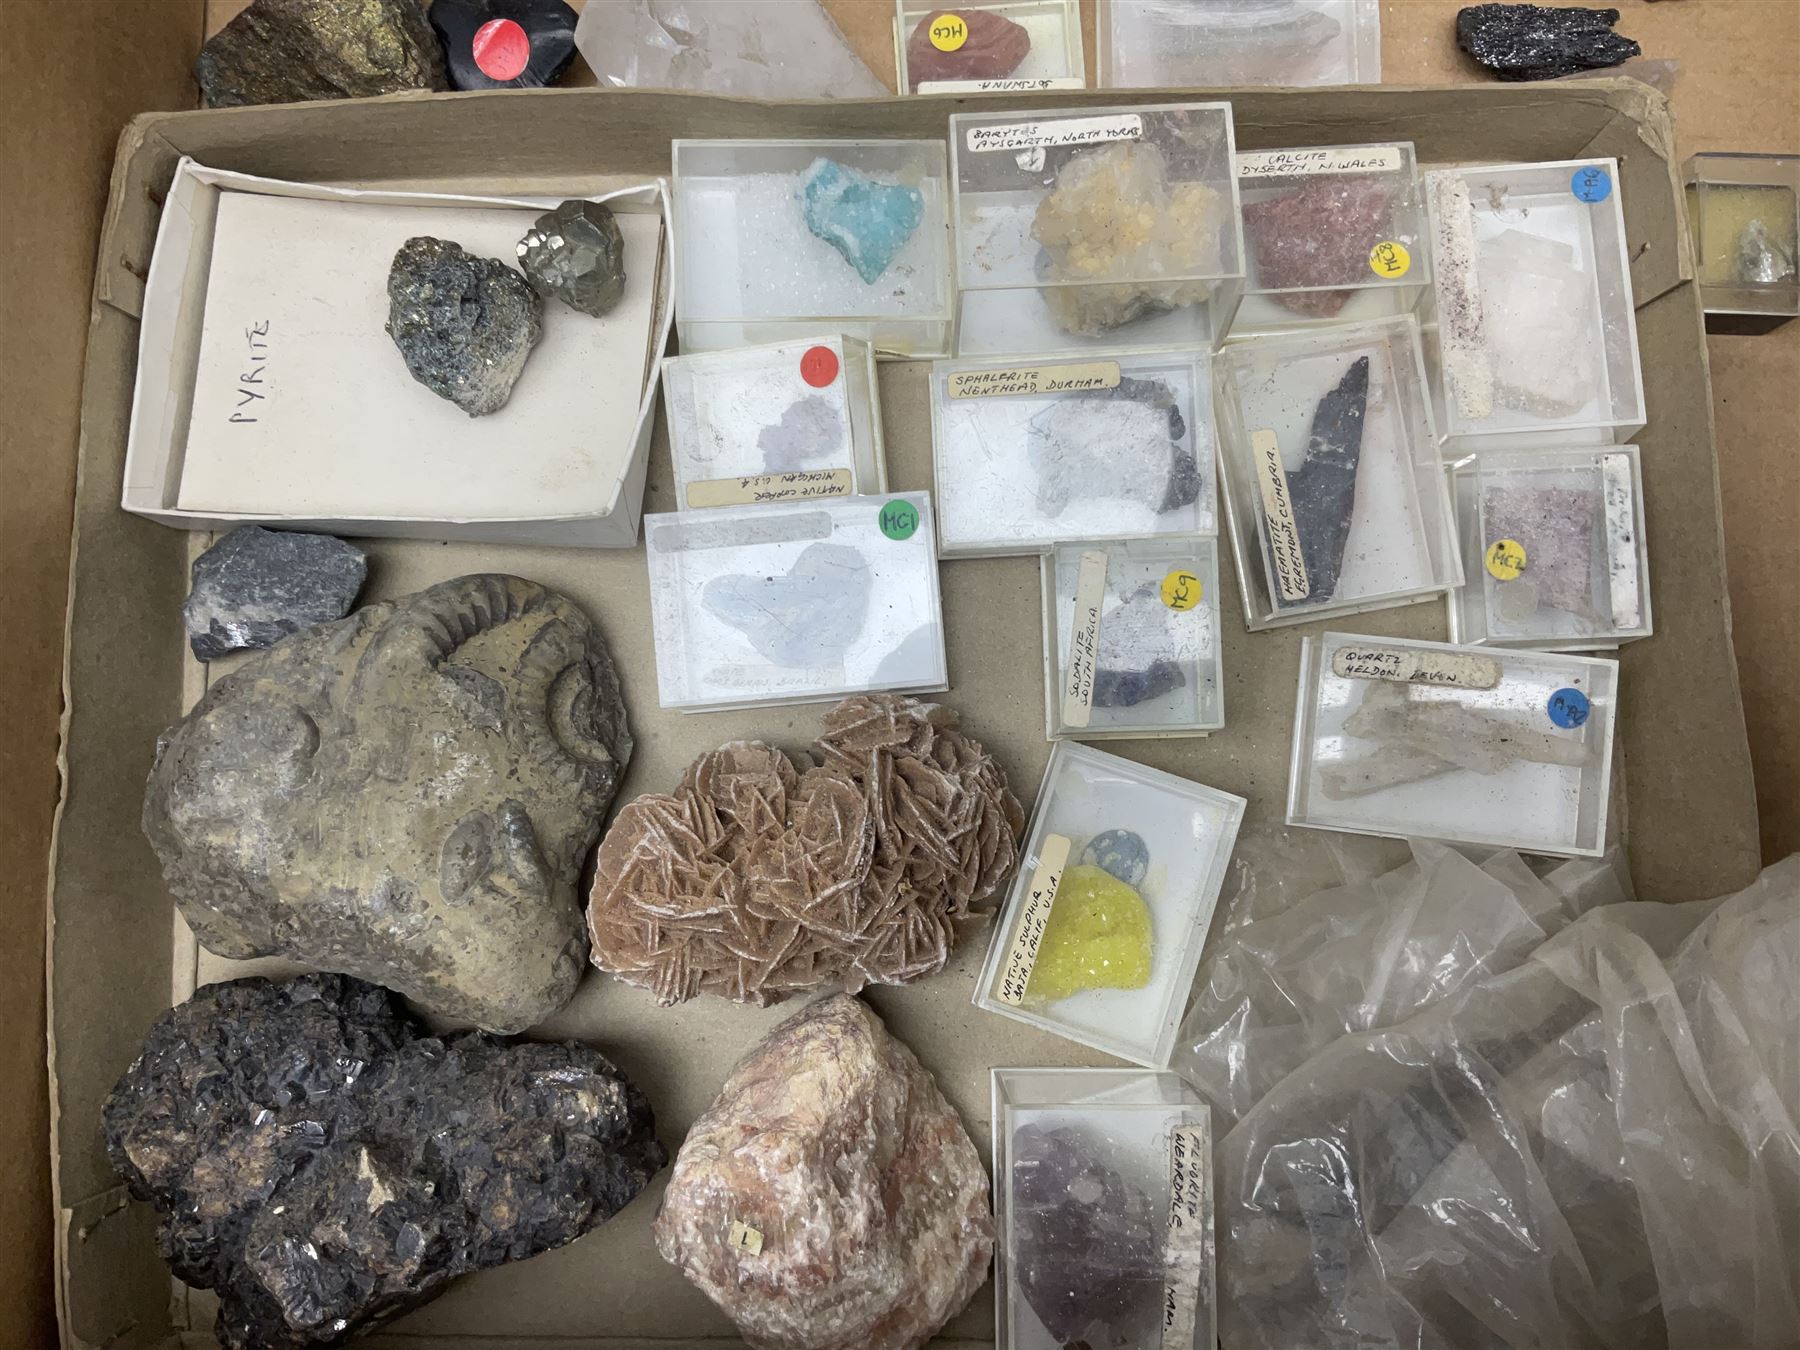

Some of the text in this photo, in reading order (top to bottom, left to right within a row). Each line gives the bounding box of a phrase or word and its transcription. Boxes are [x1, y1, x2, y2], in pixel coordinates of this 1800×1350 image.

[933, 23, 963, 39] MC6
[1061, 129, 1101, 142] NORTH
[1268, 152, 1328, 165] CALCITE
[228, 320, 270, 423] PYRITE
[955, 371, 1040, 386] SPHALERITE
[801, 484, 845, 496] NATIVE
[882, 512, 916, 531] MC1
[1267, 514, 1294, 595] HAEMATITE
[1070, 630, 1085, 698] SODALITE
[1345, 651, 1402, 664] QUARTZ
[1079, 661, 1093, 706] SOUTH
[1002, 890, 1042, 1001] NATIVE SULPHUR
